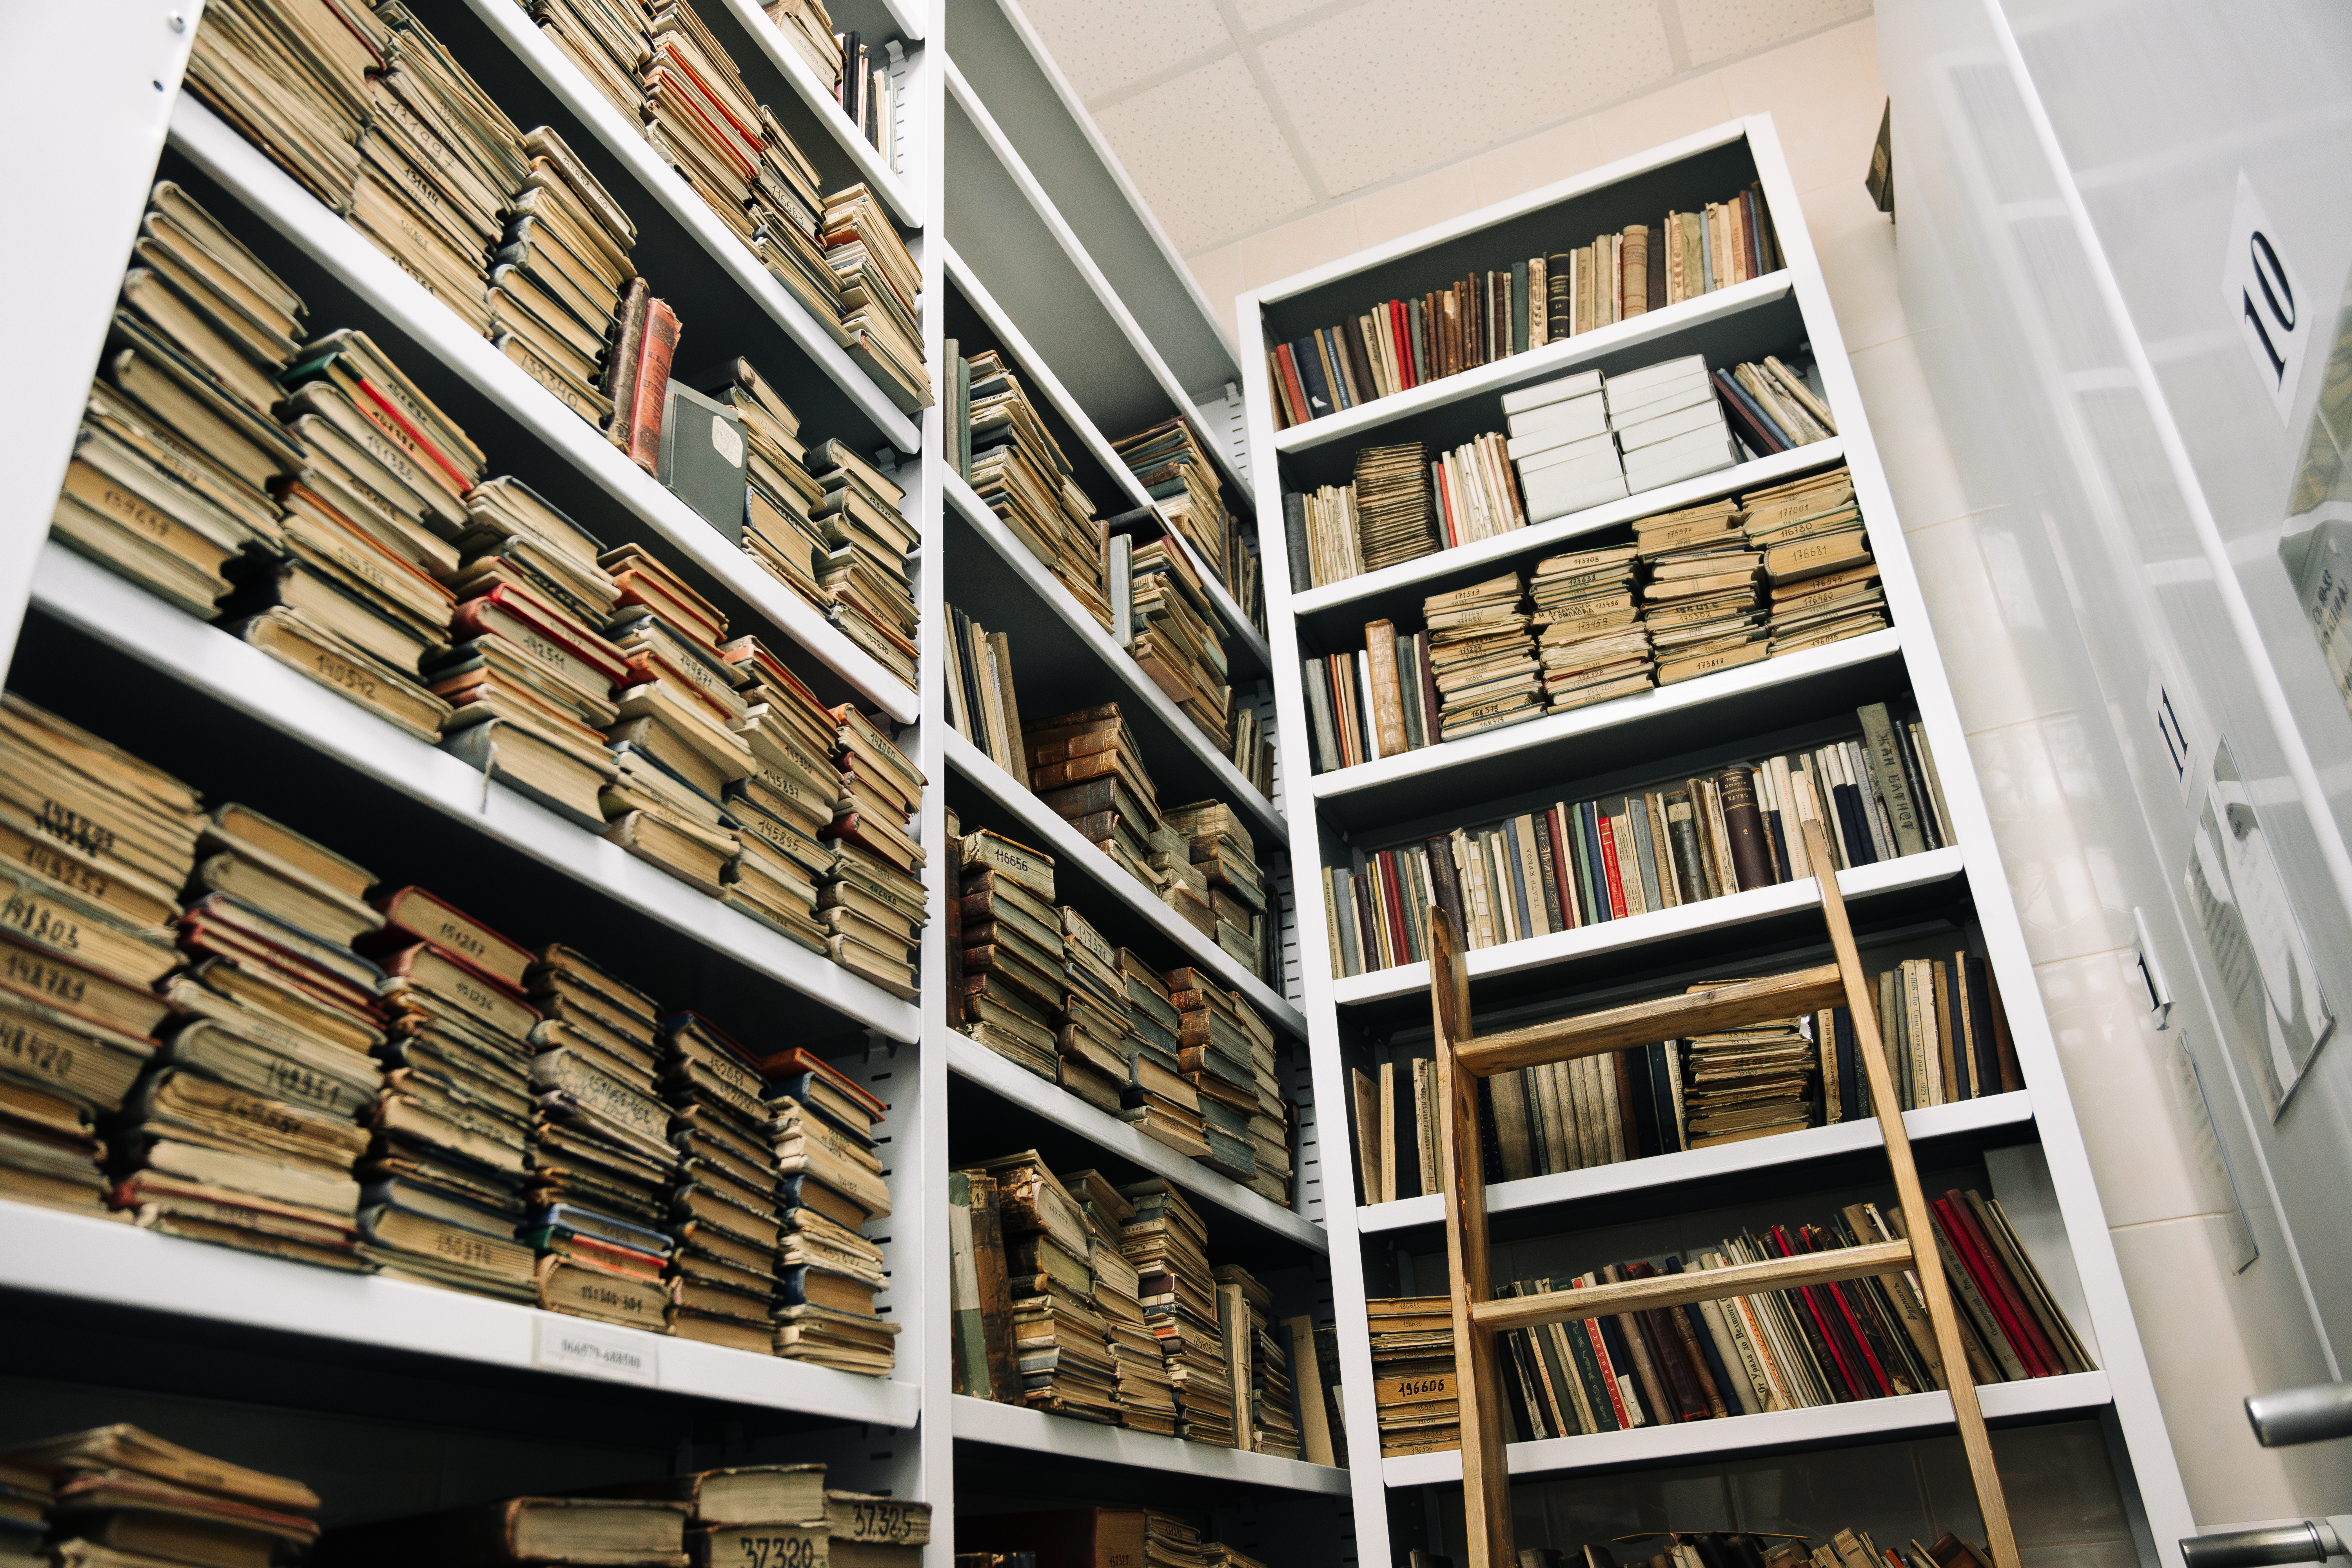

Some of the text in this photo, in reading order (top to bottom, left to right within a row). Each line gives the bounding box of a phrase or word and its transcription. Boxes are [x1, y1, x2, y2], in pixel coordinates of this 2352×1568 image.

[769, 185, 806, 224] 116663
[2242, 230, 2295, 394] 10
[519, 356, 579, 406] 133340
[1778, 504, 1809, 517] 177001
[1573, 556, 1599, 565] 173708
[1792, 546, 1827, 561] 176681
[1455, 589, 1479, 599] 171513
[1595, 600, 1619, 609] 173496
[1695, 658, 1724, 669] 173817
[2157, 683, 2188, 784] 11
[993, 848, 1029, 873] 116656
[1526, 848, 1539, 907] ТЕАТР КУКОЛ
[1724, 1305, 1766, 1393] От Урала до Великого
[1398, 1378, 1445, 1397] 196606
[1411, 1445, 1432, 1453] 196556
